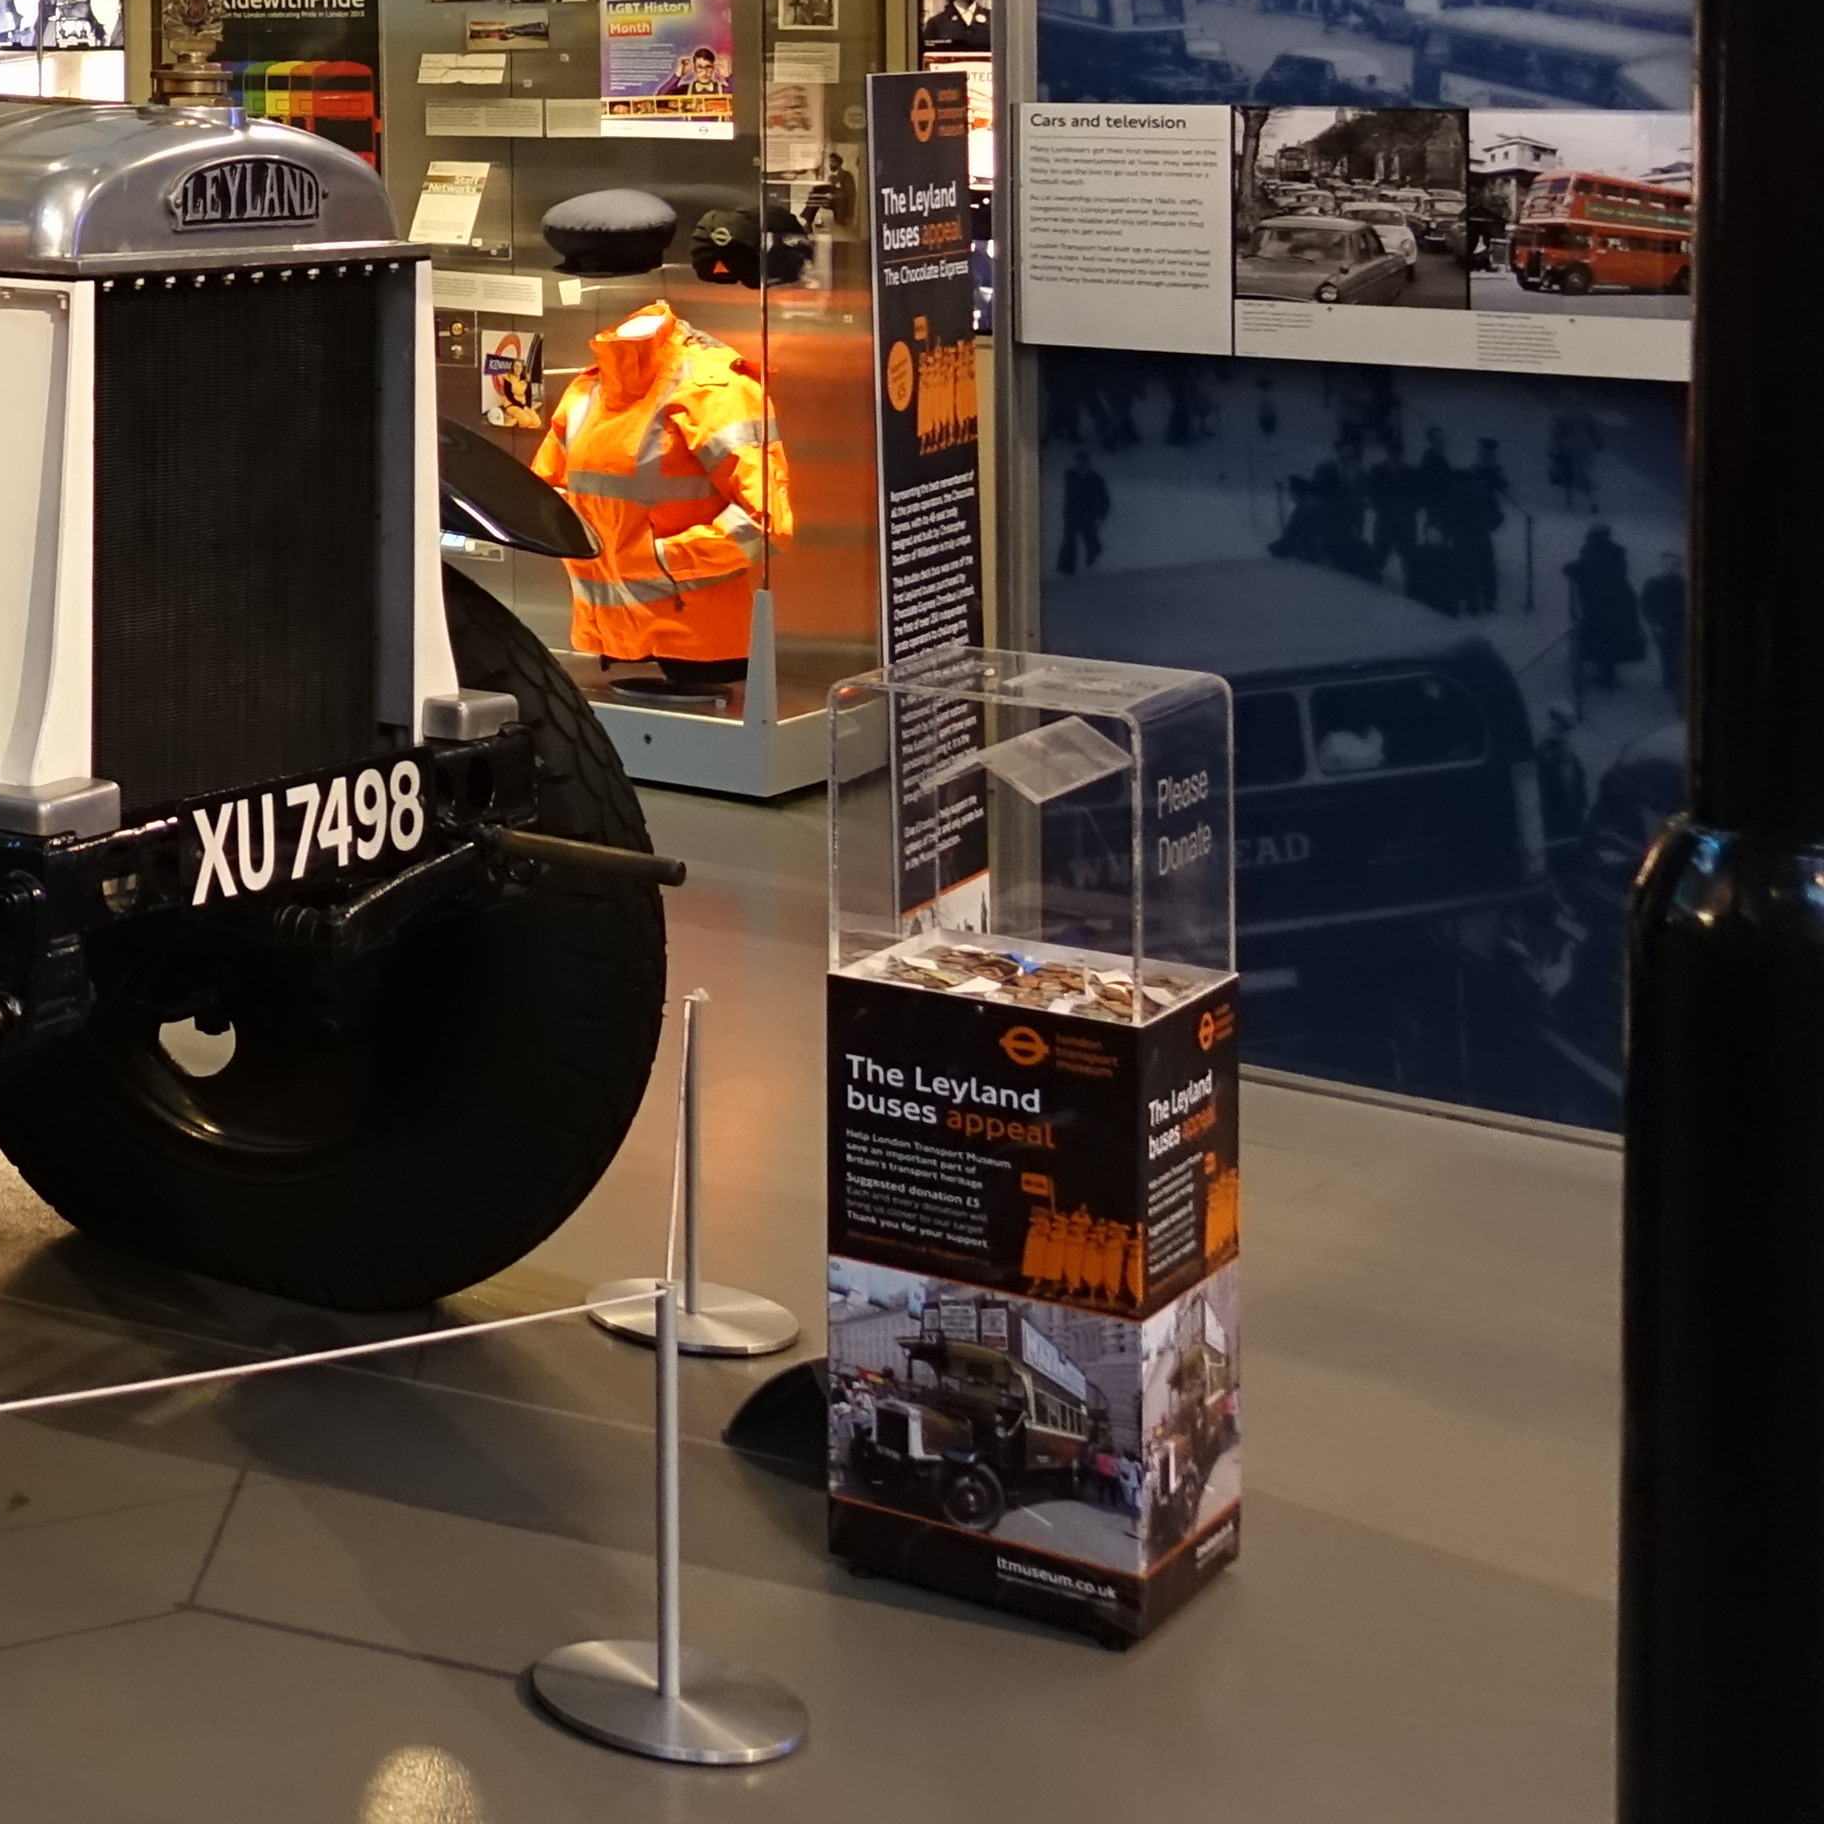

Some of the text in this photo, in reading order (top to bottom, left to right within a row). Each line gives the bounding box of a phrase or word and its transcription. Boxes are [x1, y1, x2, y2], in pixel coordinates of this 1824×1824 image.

[609, 1, 690, 16] LGBT History
[610, 21, 651, 35] Month
[1030, 113, 1187, 129] Cars and television
[183, 160, 321, 221] LEYLAND
[428, 183, 476, 194] Networks
[454, 176, 479, 185] Staff
[881, 180, 957, 217] The Leyland
[883, 214, 963, 251] buses appeal
[883, 259, 969, 287] The Chocolate Express
[1157, 769, 1209, 820] Please
[192, 760, 427, 907] XU 7498
[1158, 822, 1213, 876] Donate
[845, 1053, 1041, 1114] The Leyland
[1149, 1068, 1213, 1127] The Leyland
[846, 1085, 1056, 1149] buses appeal
[846, 1129, 1011, 1169] Help London Transport Museum
[846, 1143, 976, 1174] save an important part of
[1148, 1124, 1181, 1160] buses
[846, 1153, 983, 1189] Britain's transport heritage
[846, 1172, 905, 1193] Suggested
[908, 1185, 962, 1205] donation
[966, 1197, 980, 1208] £5
[846, 1210, 988, 1249] Thank you for your support
[996, 1555, 1117, 1600] ltmuseum.co.uk
